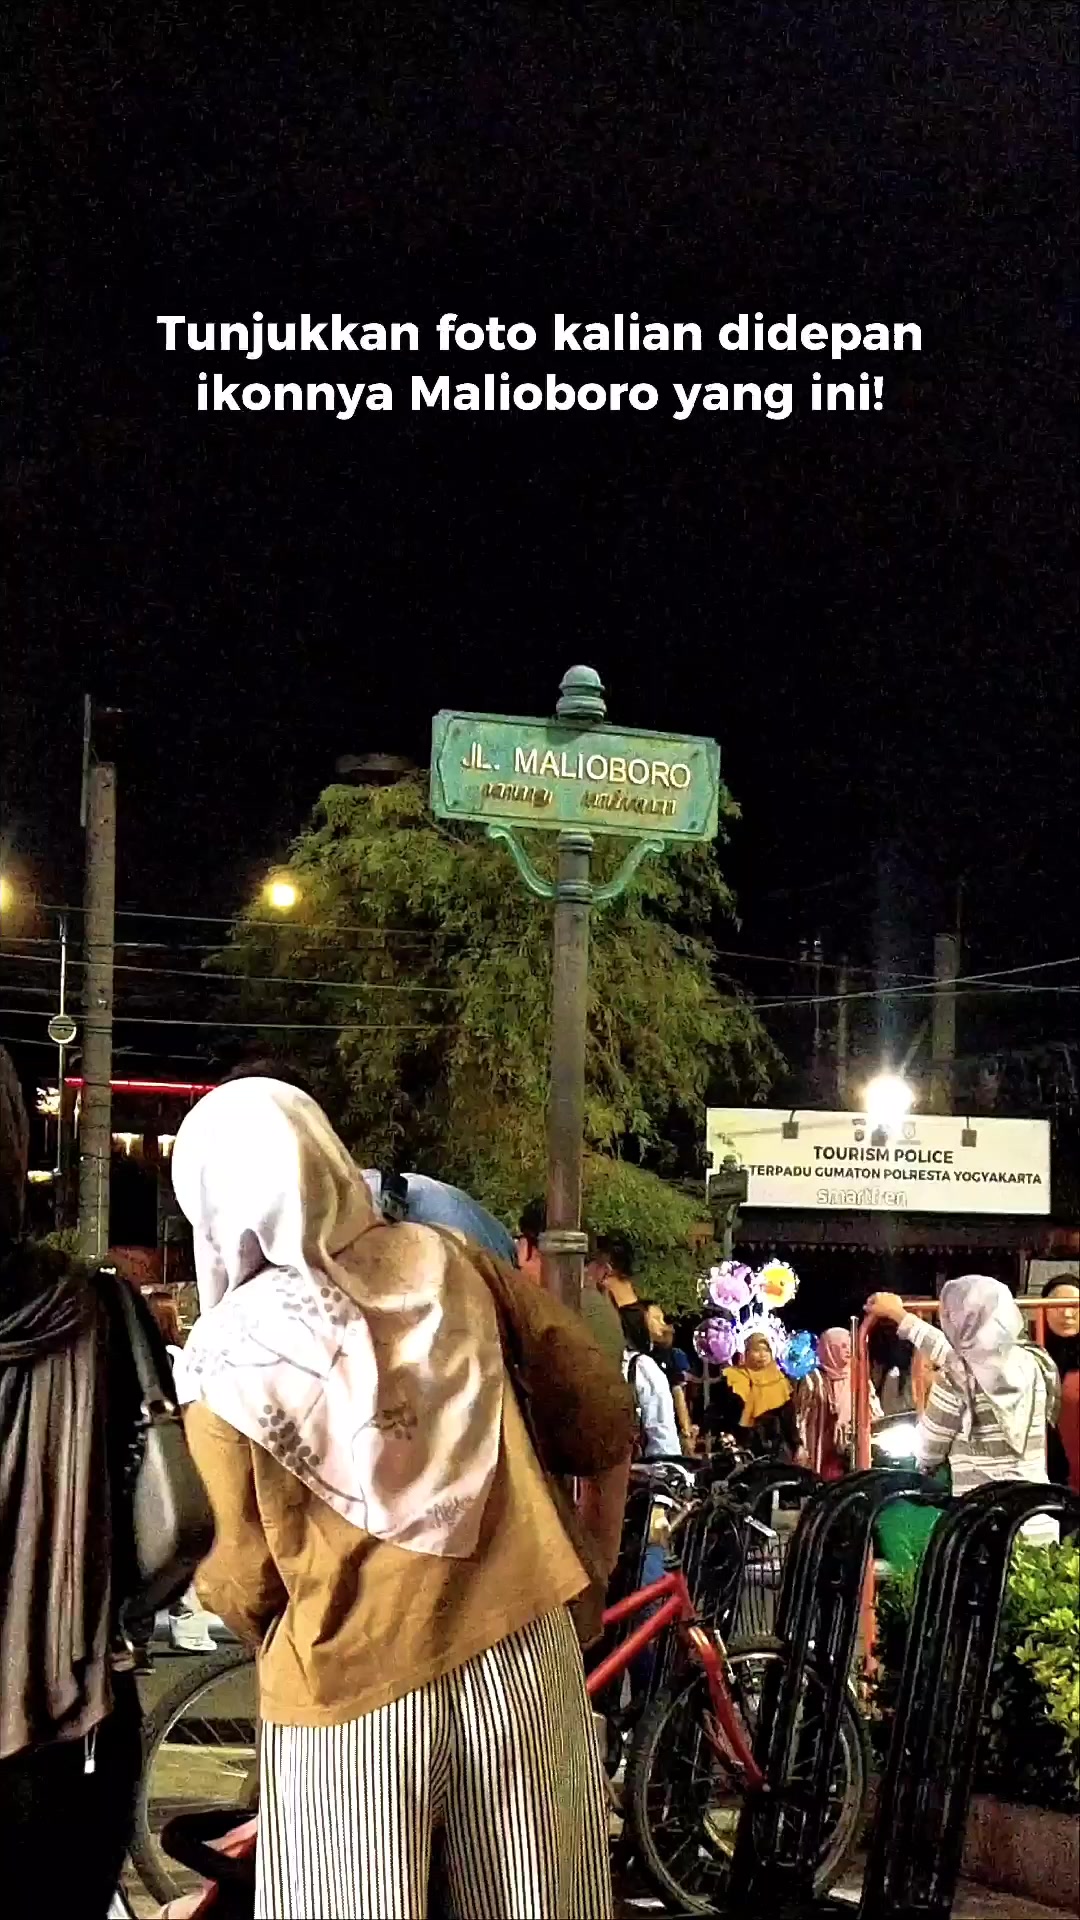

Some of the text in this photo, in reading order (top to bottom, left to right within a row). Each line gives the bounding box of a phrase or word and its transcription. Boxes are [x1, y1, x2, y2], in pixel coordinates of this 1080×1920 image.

[462, 742, 691, 789] JL. MALIOBORO
[813, 1146, 954, 1164] TOURISM POLICE
[750, 1164, 812, 1177] TERPADU
[815, 1167, 880, 1179] GUMATON
[884, 1169, 951, 1181] POLRESTA
[954, 1171, 1042, 1184] YOGYAKARTA
[816, 1187, 908, 1207] smartfren
